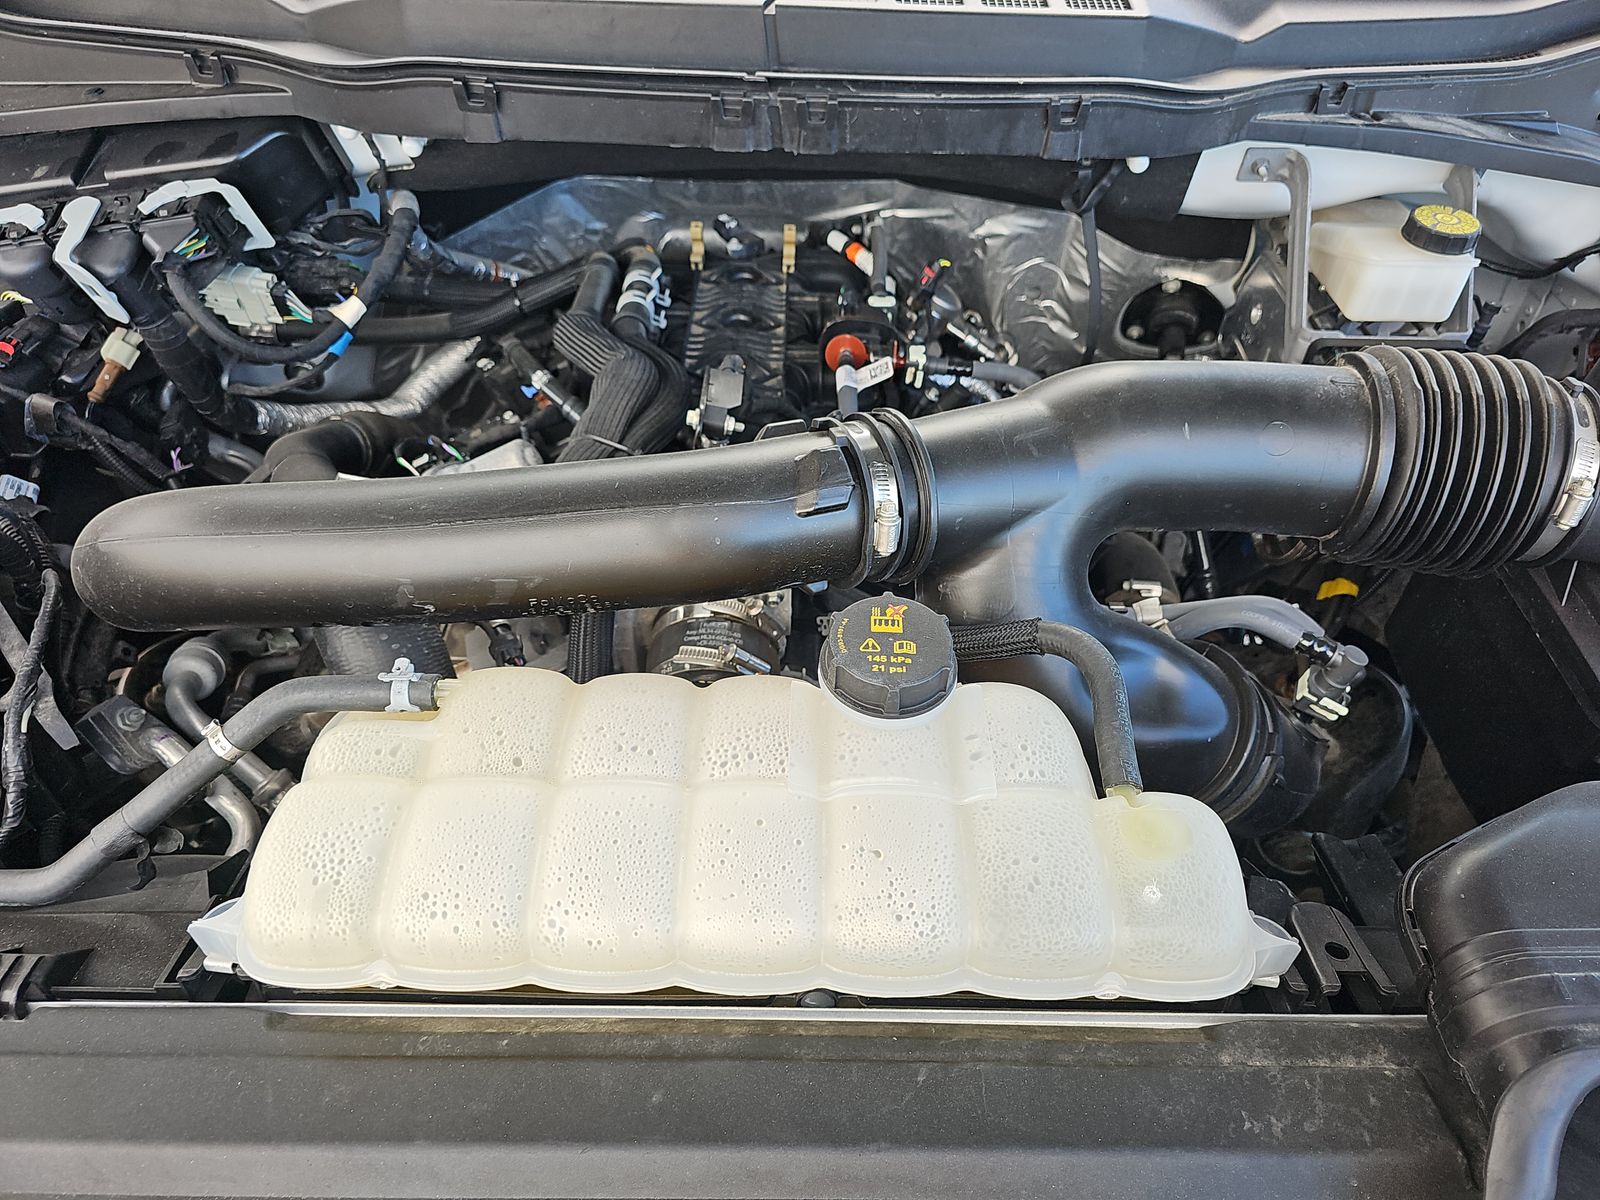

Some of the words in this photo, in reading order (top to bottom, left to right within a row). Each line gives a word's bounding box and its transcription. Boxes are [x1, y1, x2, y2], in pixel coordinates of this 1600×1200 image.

[866, 654, 888, 663] 145
[890, 655, 912, 664] kPa
[871, 664, 886, 673] 21
[889, 665, 907, 674] psi
